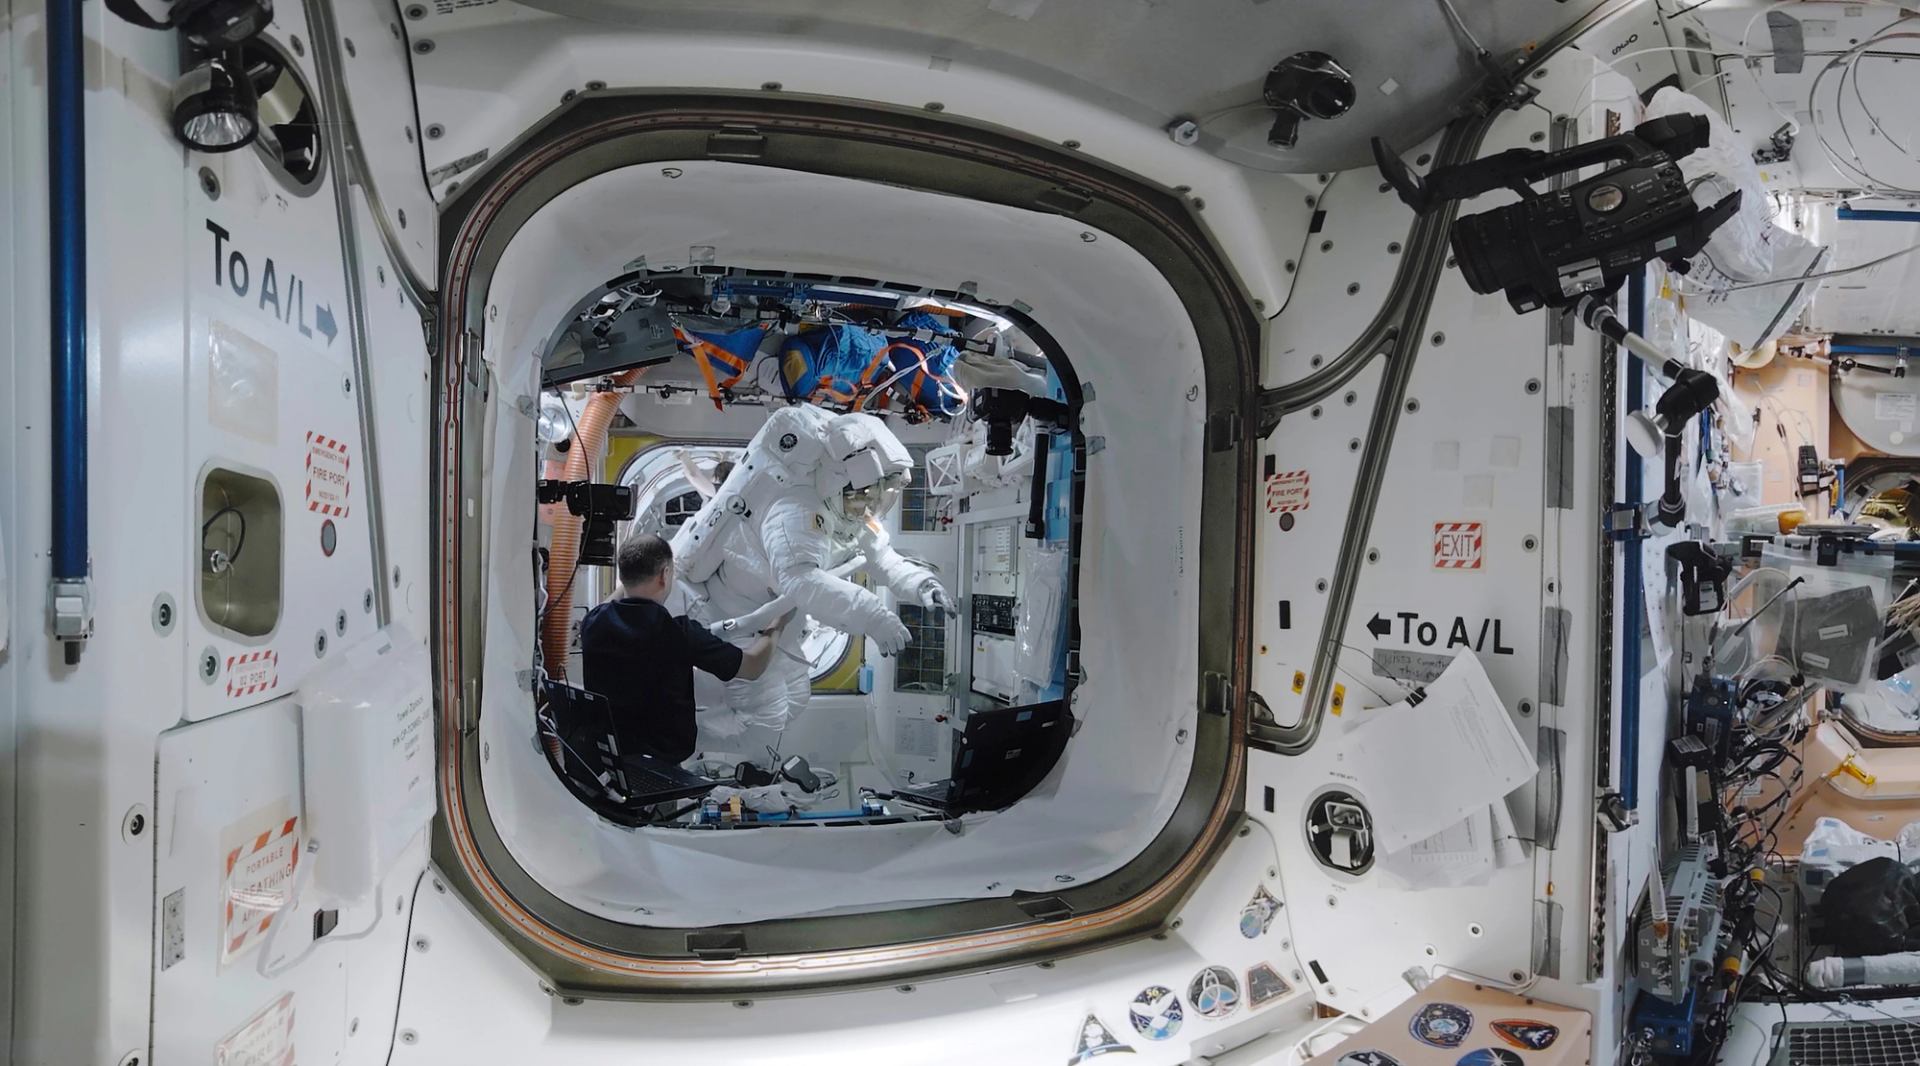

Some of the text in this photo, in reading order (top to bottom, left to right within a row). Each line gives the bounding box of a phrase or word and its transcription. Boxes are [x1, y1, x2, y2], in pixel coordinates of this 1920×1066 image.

[206, 217, 313, 340] To A/L
[312, 465, 346, 487] FIRE PORT
[1286, 487, 1303, 496] PORT
[1441, 533, 1475, 558] EXIT
[1396, 611, 1515, 656] To A/L
[245, 845, 285, 877] PORTABLE
